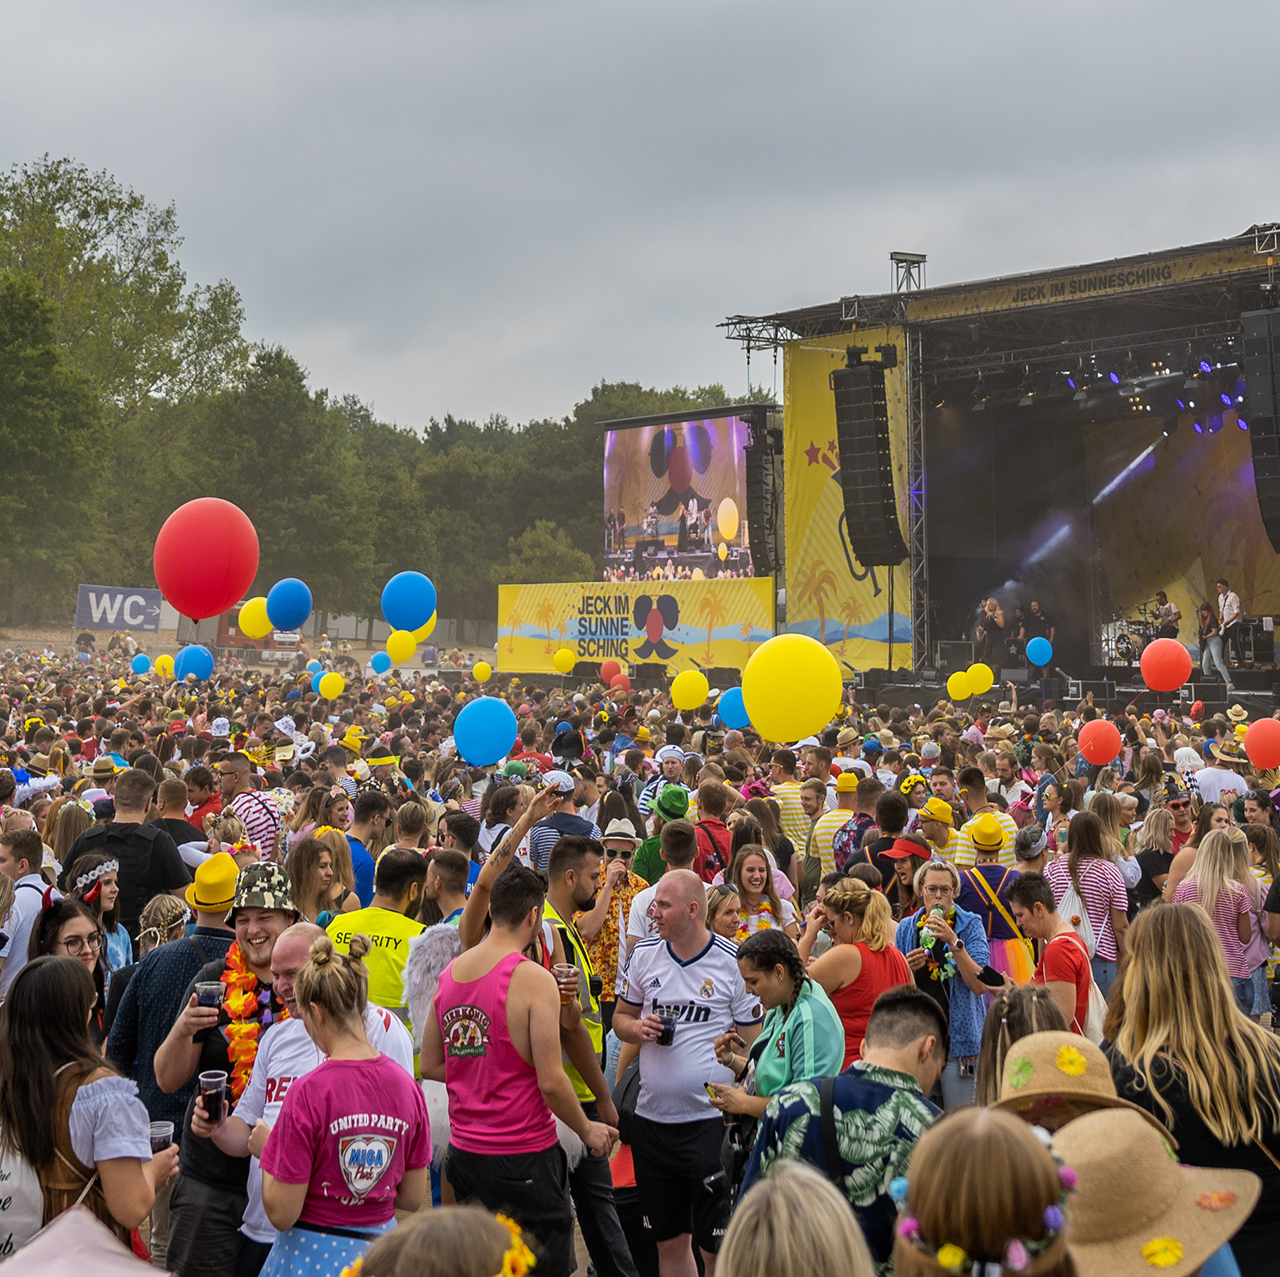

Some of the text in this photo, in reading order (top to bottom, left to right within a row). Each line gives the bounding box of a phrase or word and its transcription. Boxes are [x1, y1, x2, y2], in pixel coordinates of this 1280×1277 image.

[1012, 265, 1172, 303] JECK IM SUNNESCHING
[88, 592, 146, 625] WC
[577, 595, 629, 615] JECK IM
[577, 616, 629, 636] SUNNE
[577, 637, 629, 658] SCHING
[335, 931, 403, 950] SERITY
[329, 1113, 410, 1136] UNITED PARTY
[348, 1148, 384, 1167] MEGA
